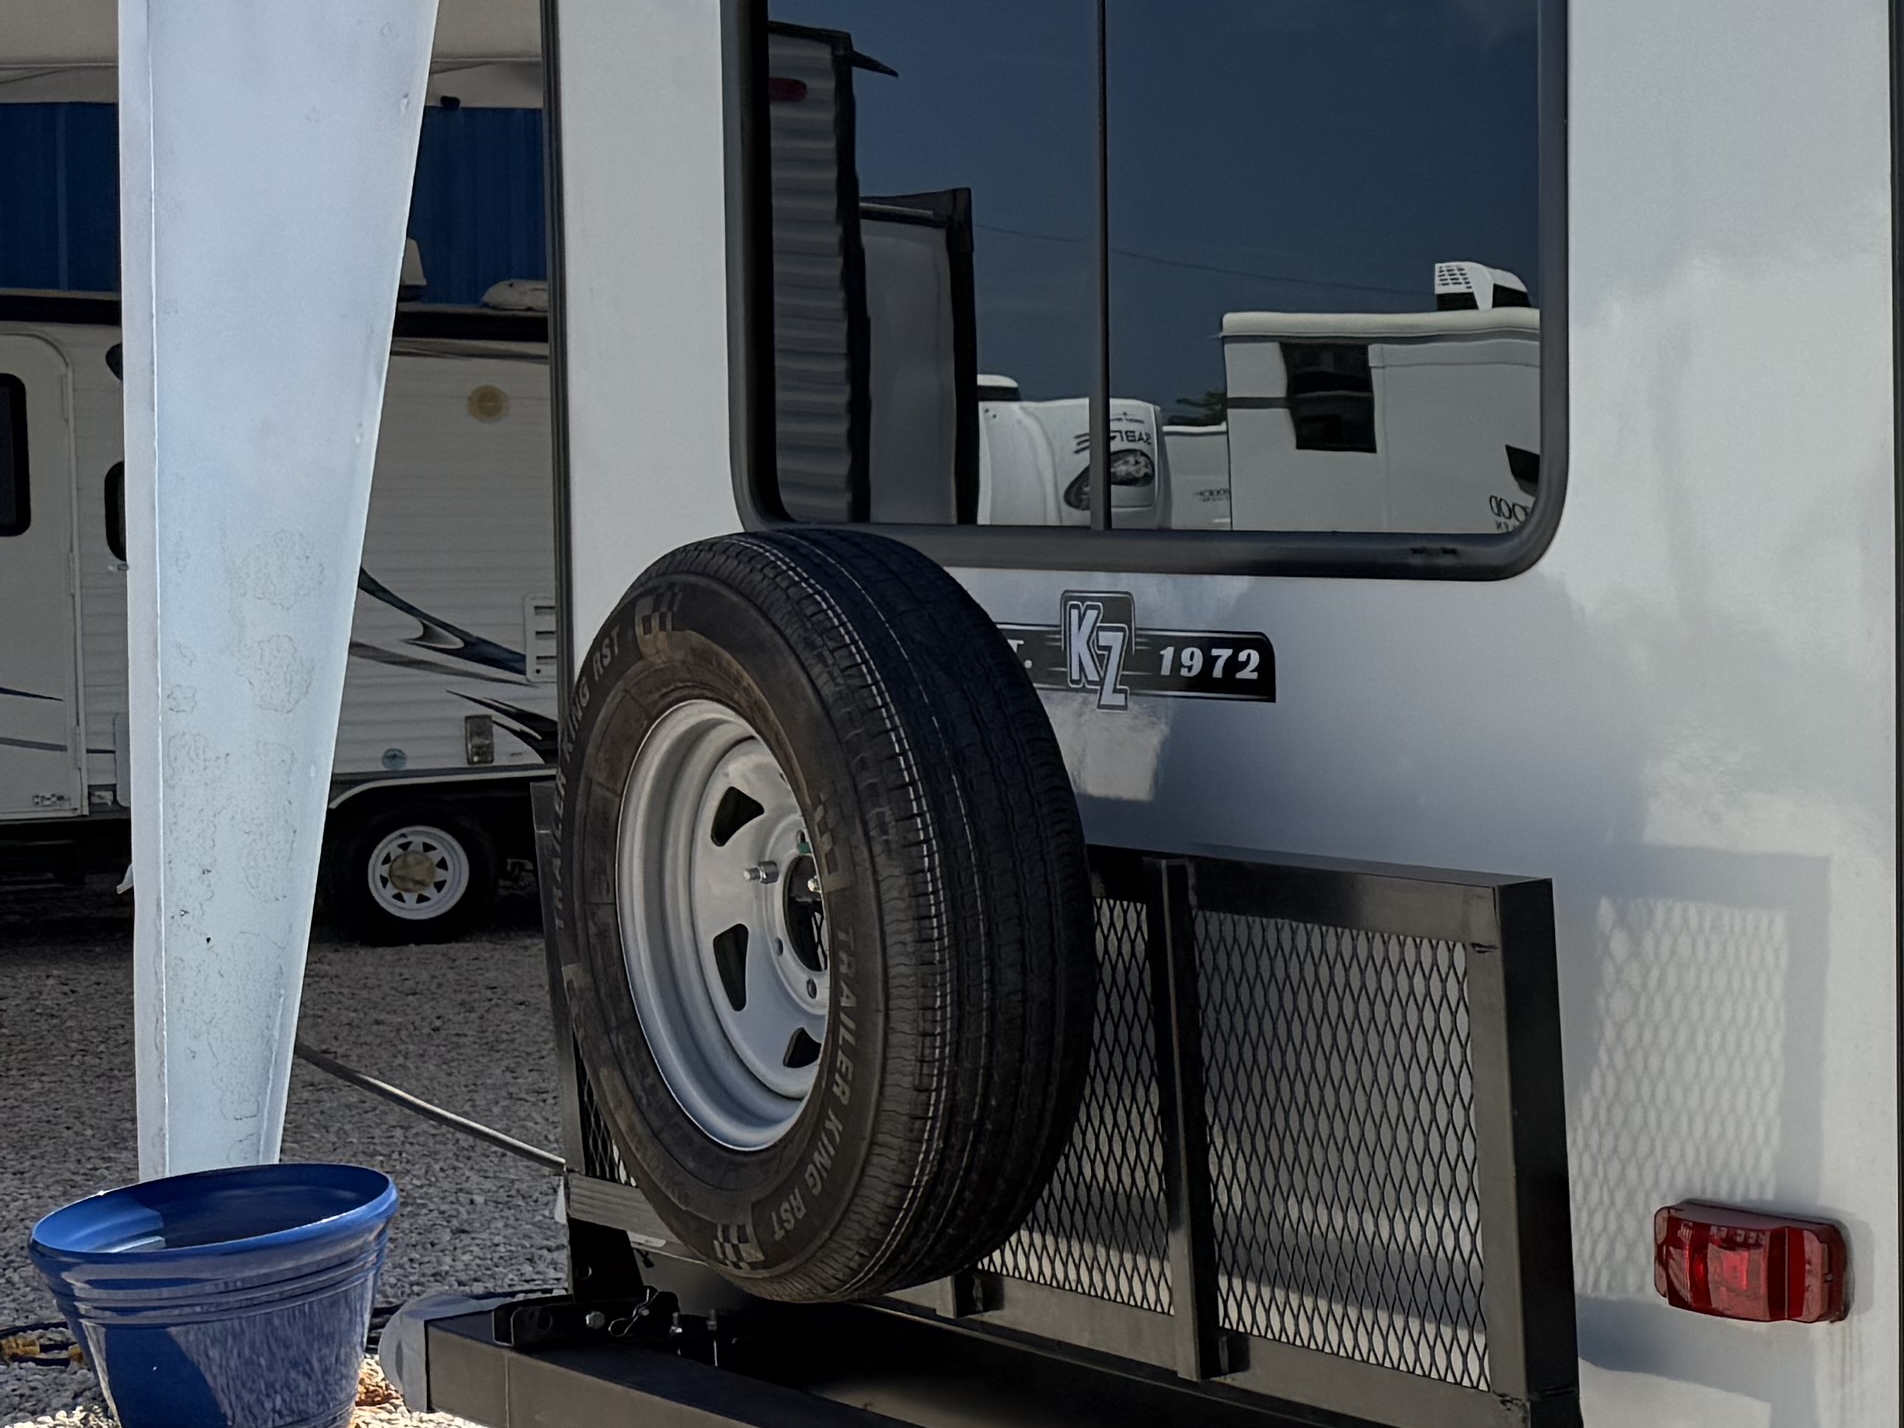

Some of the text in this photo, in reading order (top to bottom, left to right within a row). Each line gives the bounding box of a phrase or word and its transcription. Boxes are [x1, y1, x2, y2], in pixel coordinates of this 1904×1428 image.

[592, 624, 621, 682] RST
[1067, 602, 1130, 709] KZ
[1159, 645, 1261, 680] 1972
[771, 925, 858, 1241] TRAILER KING RST
